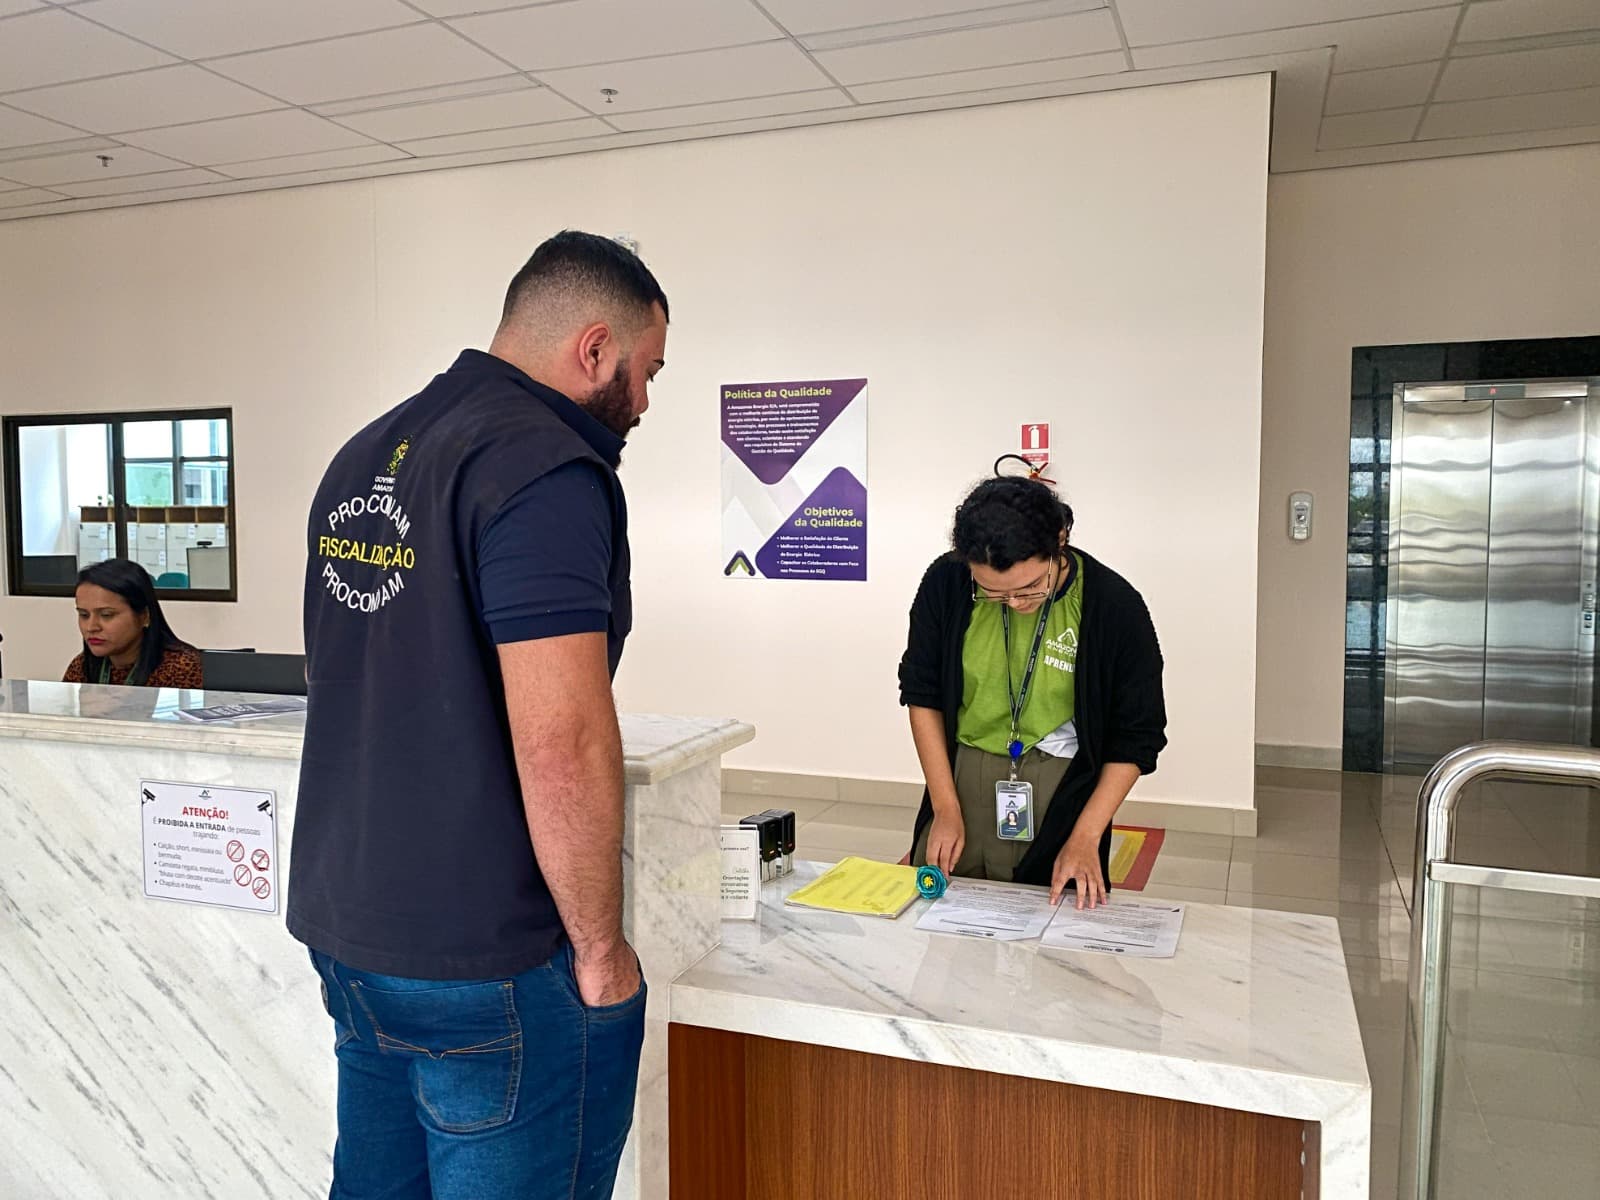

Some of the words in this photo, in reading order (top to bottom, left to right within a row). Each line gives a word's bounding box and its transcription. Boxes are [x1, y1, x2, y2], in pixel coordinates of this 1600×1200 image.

[725, 389, 761, 399] Política
[764, 388, 777, 398] da
[779, 386, 832, 398] Qualidade
[804, 506, 854, 518] Objetivos
[794, 518, 807, 527] da
[810, 518, 863, 528] Qualidade
[182, 806, 229, 820] ATENÇÃO!
[158, 818, 188, 828] PROIBIDA
[196, 821, 226, 832] ENTRADA
